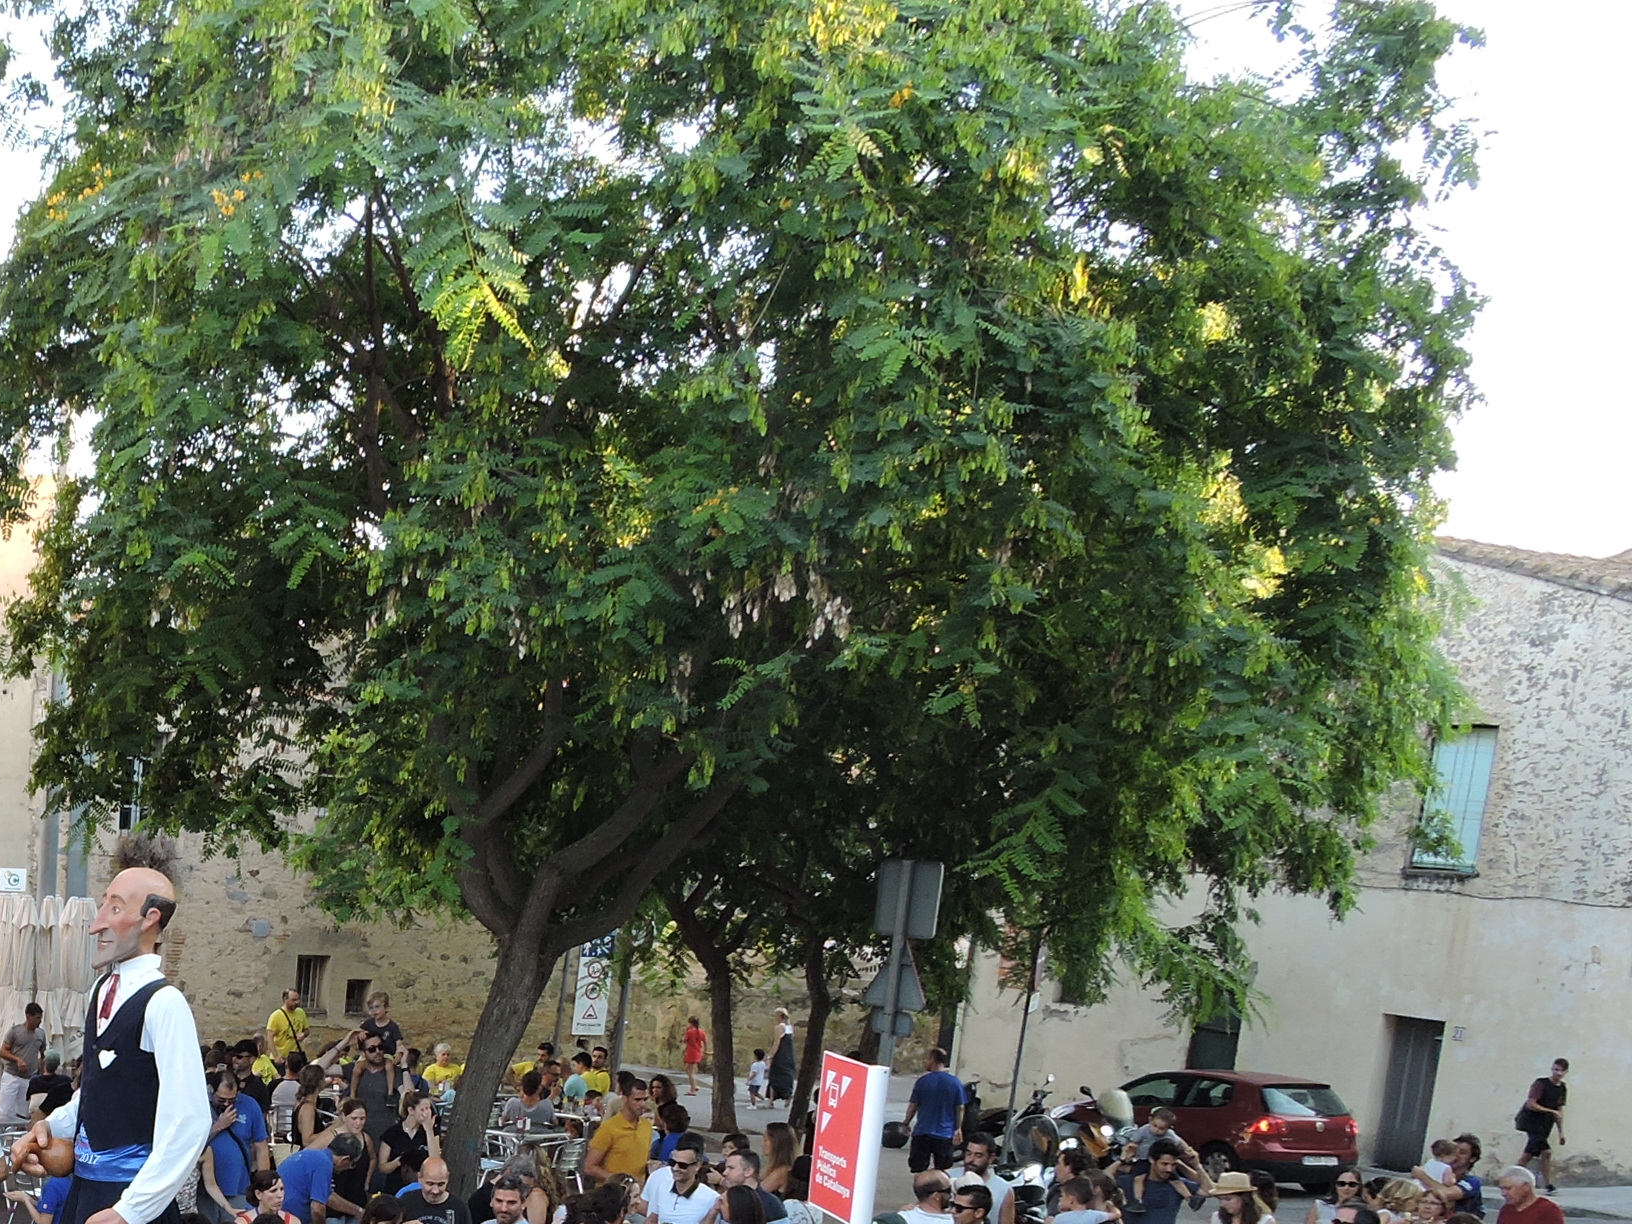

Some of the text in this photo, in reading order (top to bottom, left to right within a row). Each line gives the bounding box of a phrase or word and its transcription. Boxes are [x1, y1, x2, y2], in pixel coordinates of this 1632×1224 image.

[78, 1152, 101, 1166] 2017
[818, 1145, 847, 1169] Transports
[815, 1160, 837, 1178] Públics
[815, 1172, 850, 1199] de Catalunya
